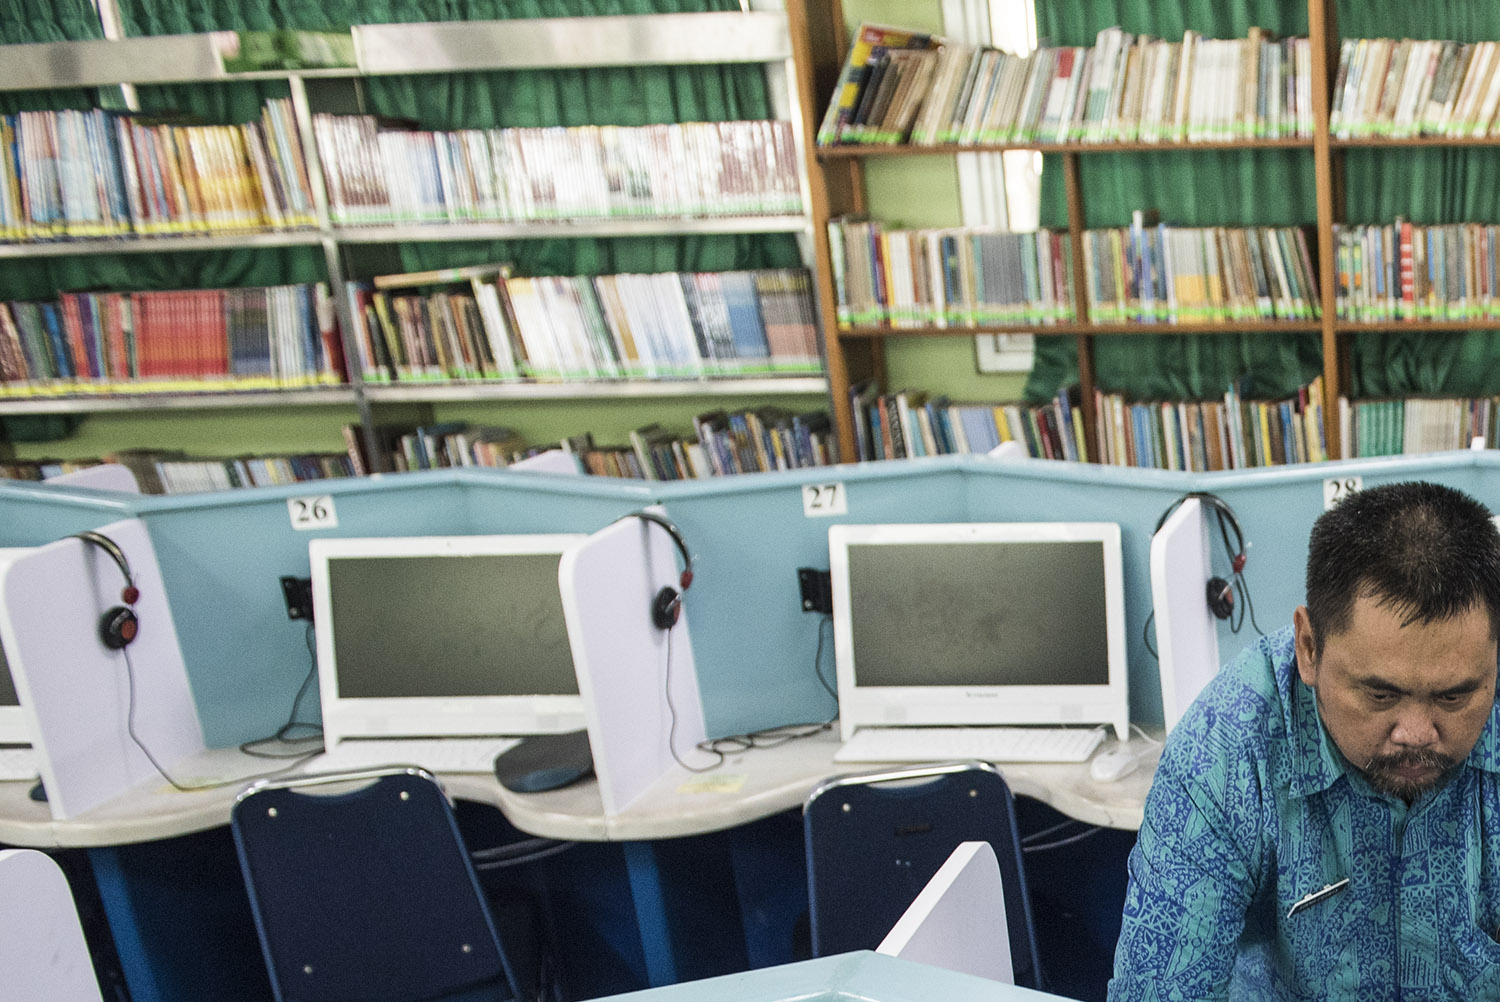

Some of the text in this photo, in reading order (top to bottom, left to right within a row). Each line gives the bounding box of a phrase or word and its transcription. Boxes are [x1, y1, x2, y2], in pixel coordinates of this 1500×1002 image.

[808, 485, 837, 508] 27
[1330, 479, 1356, 502] 28
[294, 497, 327, 521] 26
